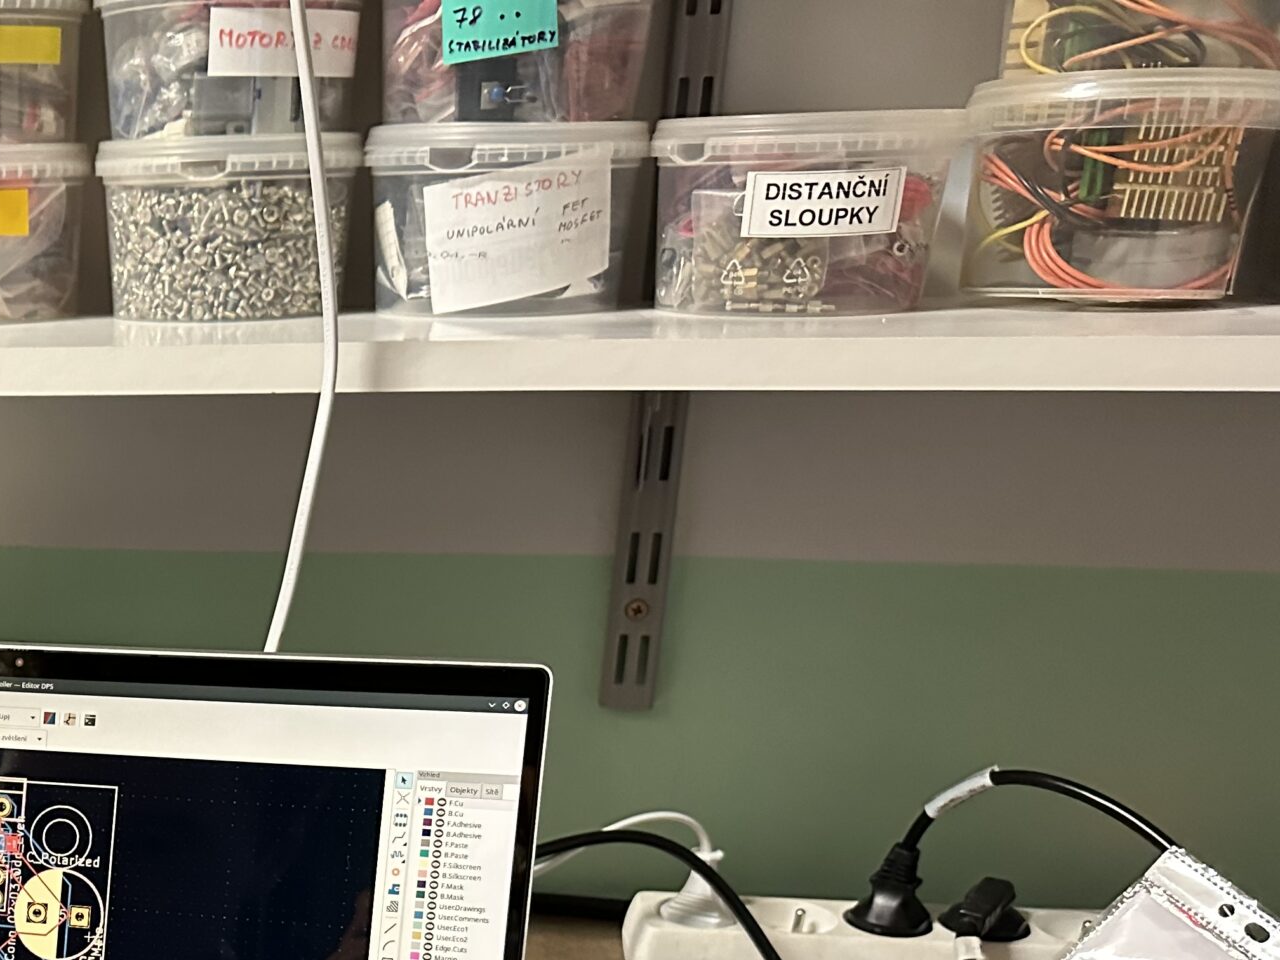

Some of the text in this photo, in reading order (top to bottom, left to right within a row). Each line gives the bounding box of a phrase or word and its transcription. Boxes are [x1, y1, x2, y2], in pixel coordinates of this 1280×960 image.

[452, 7, 483, 28] 78
[218, 28, 297, 50] MOTOR
[765, 173, 890, 201] DISTANČNÍ
[562, 197, 589, 216] FET
[558, 210, 604, 233] MOSFET
[768, 205, 879, 227] SLOUPKY
[21, 682, 40, 690] Editor
[41, 682, 54, 690] DPS
[420, 785, 442, 793] Vrstvy
[450, 787, 478, 795] Objekty
[447, 821, 482, 829] F.Adhesive
[446, 831, 482, 839] B.Adhesive
[26, 851, 100, 868] C_Polarized
[443, 862, 482, 870] F.Silkscreen
[442, 873, 482, 881] B.Silkscreen
